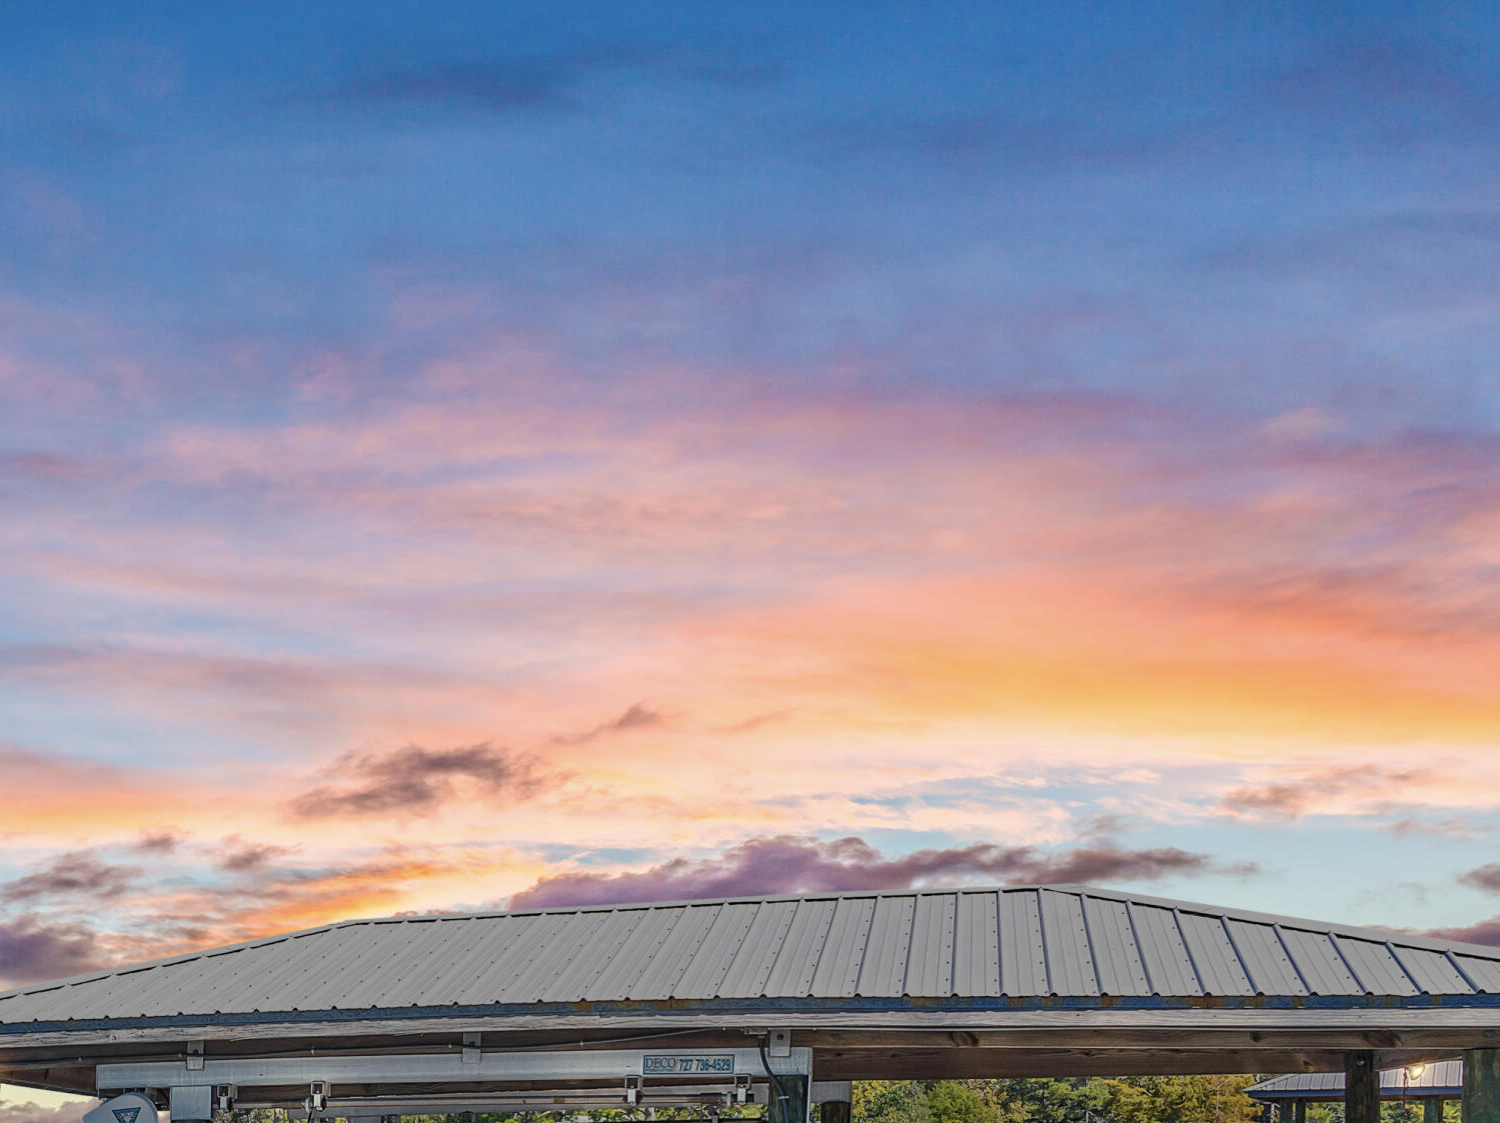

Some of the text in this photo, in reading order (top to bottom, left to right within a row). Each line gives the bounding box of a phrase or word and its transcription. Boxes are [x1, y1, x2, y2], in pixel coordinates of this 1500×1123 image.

[645, 1057, 677, 1069] DECO
[679, 1059, 693, 1071] 727
[695, 1058, 731, 1071] 736-4529
